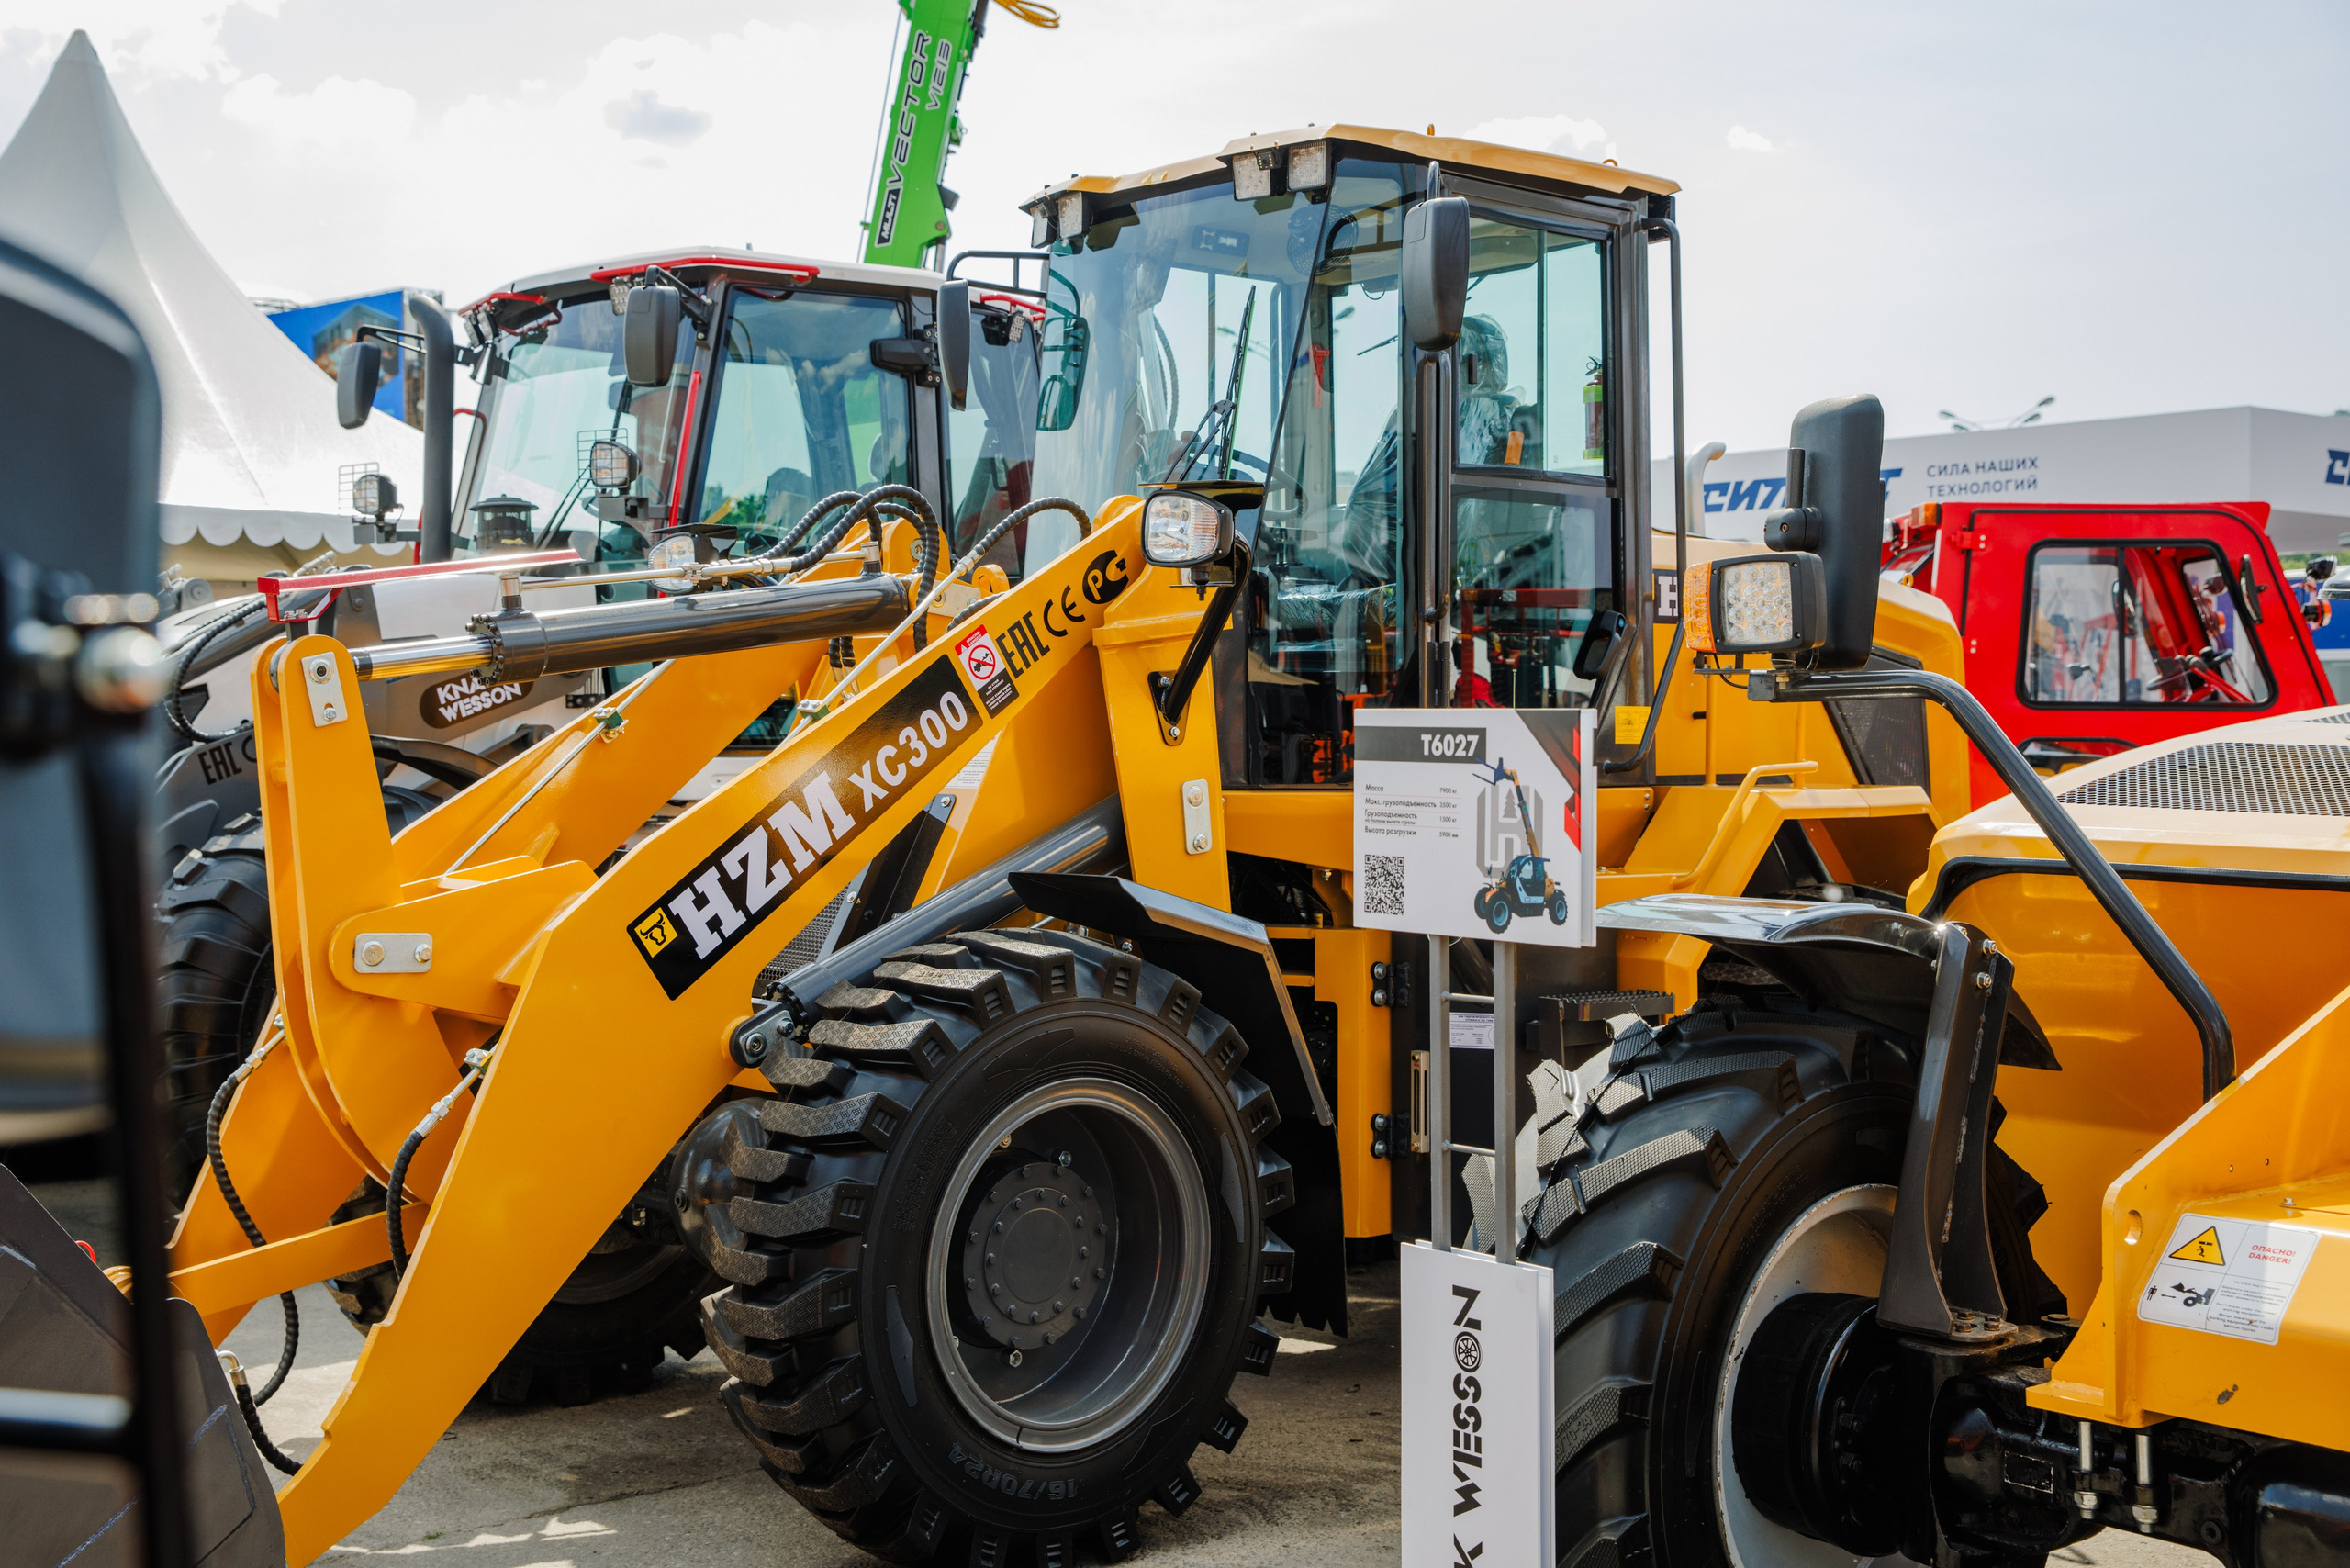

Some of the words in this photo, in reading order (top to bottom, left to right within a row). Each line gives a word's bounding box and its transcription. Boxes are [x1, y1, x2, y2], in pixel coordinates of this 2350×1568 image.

[887, 31, 931, 186] VECTOR
[880, 194, 897, 241] MULTI
[1927, 464, 1969, 477] СИЛА
[1975, 457, 2038, 474] НАШИХ
[1927, 475, 2038, 497] ТЕХНОЛОГИЙ
[438, 683, 522, 722] WESSON
[1420, 734, 1480, 756] T6027
[1365, 784, 1384, 792] Масса
[1365, 797, 1382, 806] Макс.
[667, 770, 856, 960] HZM
[846, 691, 968, 813] XC300
[1364, 825, 1385, 834] Высота
[1385, 828, 1416, 838] разгрузки
[2248, 1252, 2292, 1265] DANGER!
[2252, 1244, 2297, 1257] ОПАСНО!
[1452, 1284, 1483, 1517] WESSON
[947, 1441, 1078, 1500] 16/70R24
